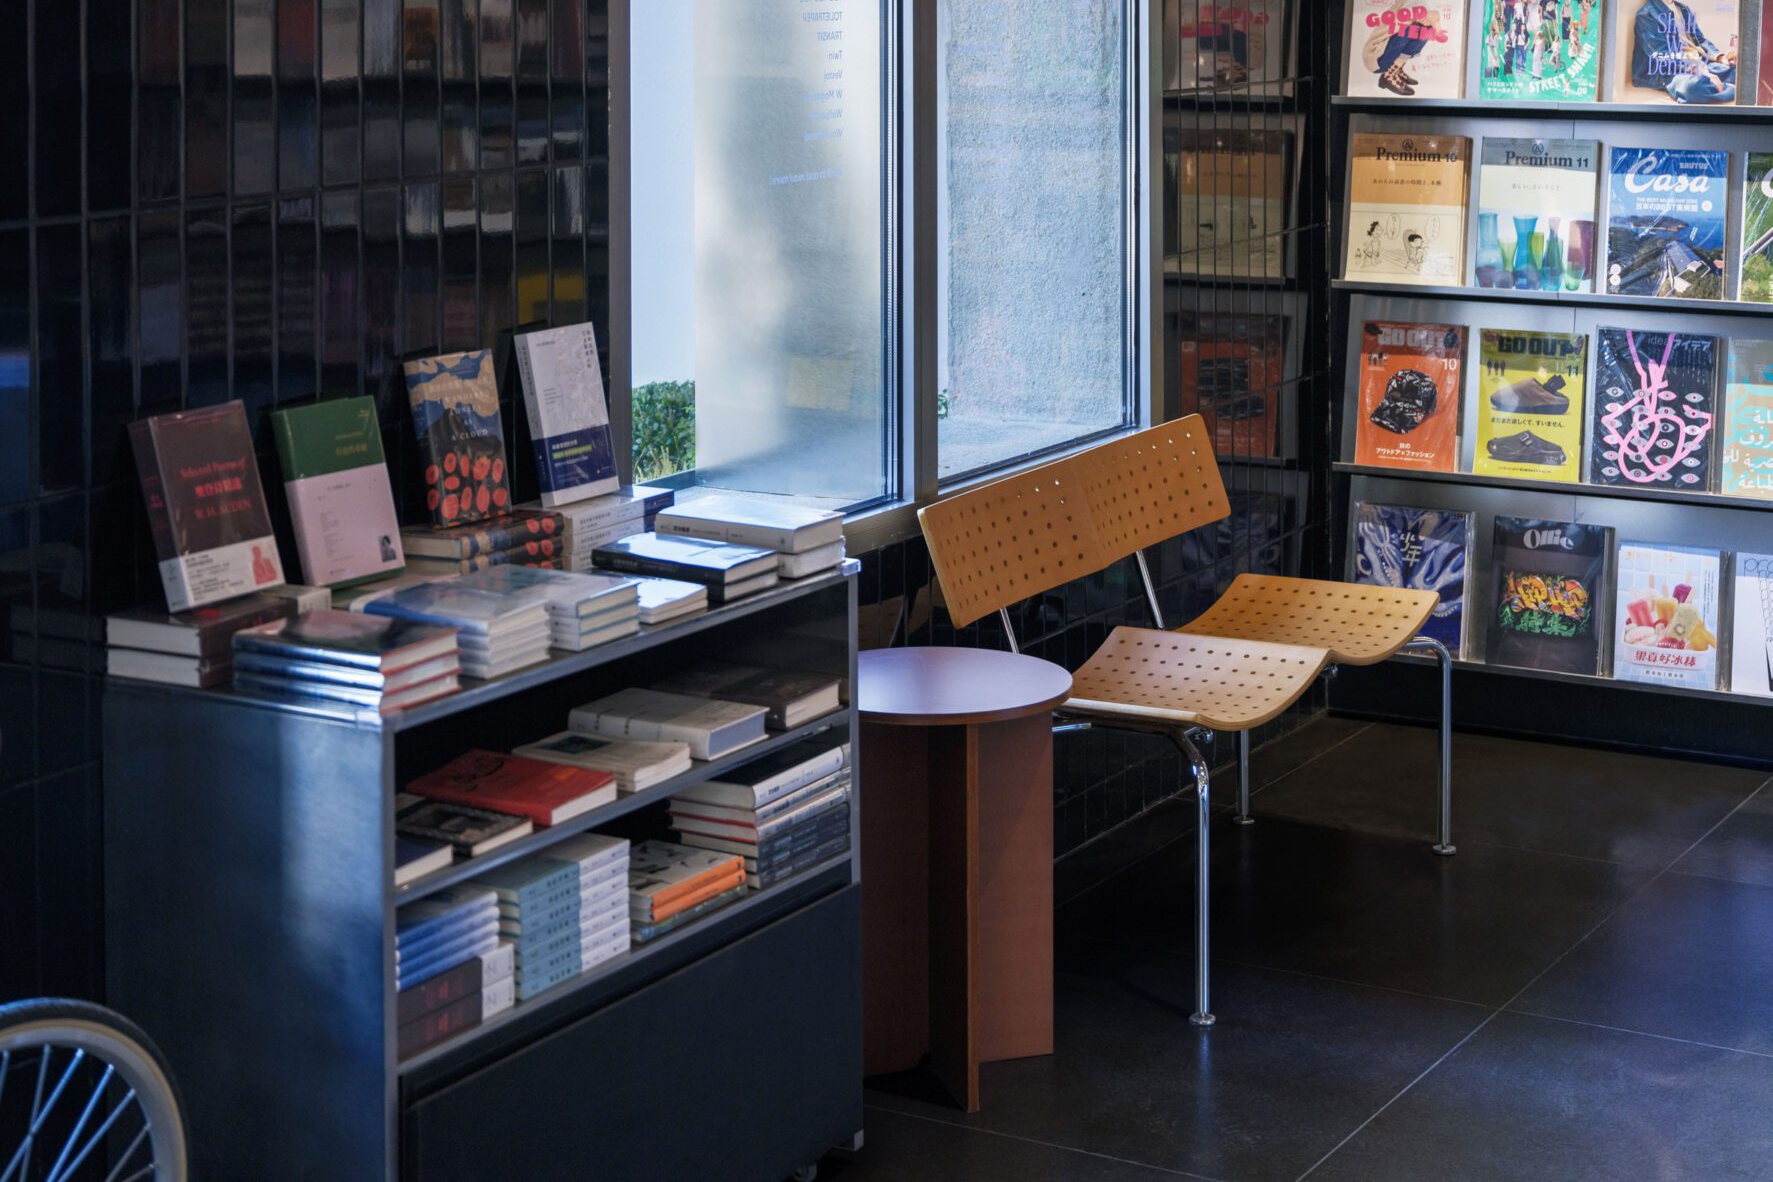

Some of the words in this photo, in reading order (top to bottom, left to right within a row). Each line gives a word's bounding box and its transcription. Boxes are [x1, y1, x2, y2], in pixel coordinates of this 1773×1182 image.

[1366, 6, 1427, 28] GOOD
[1388, 21, 1448, 43] ITEMS
[1528, 74, 1567, 93] STREET
[1376, 147, 1440, 162] Premium
[1445, 153, 1458, 162] 10
[1506, 150, 1572, 167] Premium
[1577, 158, 1588, 168] 11
[1624, 151, 1710, 194] Casa
[1498, 336, 1526, 354] GO
[1442, 359, 1456, 370] 10
[1524, 529, 1574, 550] Ollie
